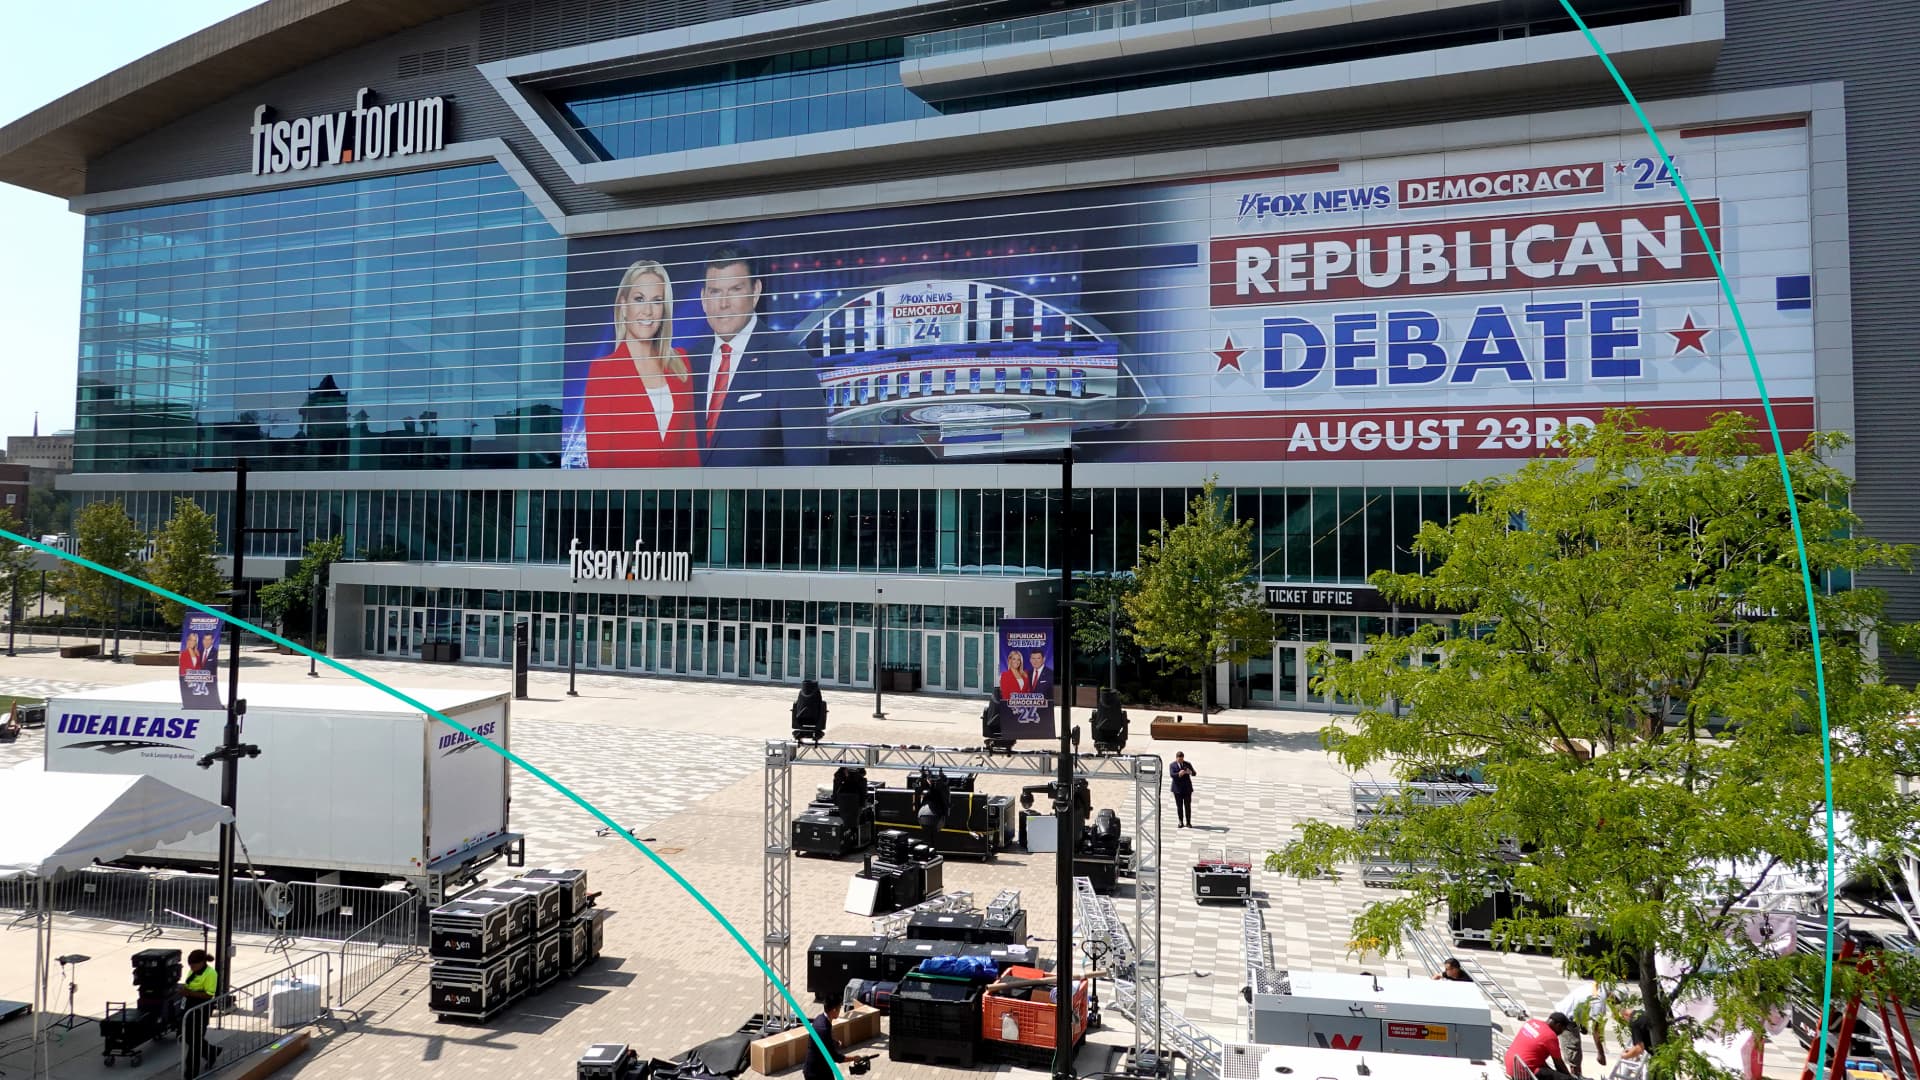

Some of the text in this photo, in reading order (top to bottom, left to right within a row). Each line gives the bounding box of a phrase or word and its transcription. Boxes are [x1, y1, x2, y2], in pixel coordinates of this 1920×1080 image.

[1256, 192, 1308, 219] FOX
[1313, 185, 1390, 214] NEWS
[1406, 167, 1595, 203] DEMOCRACY
[1236, 215, 1682, 296] REPUBLICAN
[896, 303, 959, 317] DEMOCRACY
[906, 292, 953, 304] FOX NEWS
[914, 317, 941, 340] 24
[1263, 299, 1641, 389] DEBATE
[1287, 418, 1465, 452] AUGUST
[1268, 589, 1353, 605] TICKET OFFICE
[1019, 706, 1038, 721] 24
[56, 713, 201, 739] IDEALEASE
